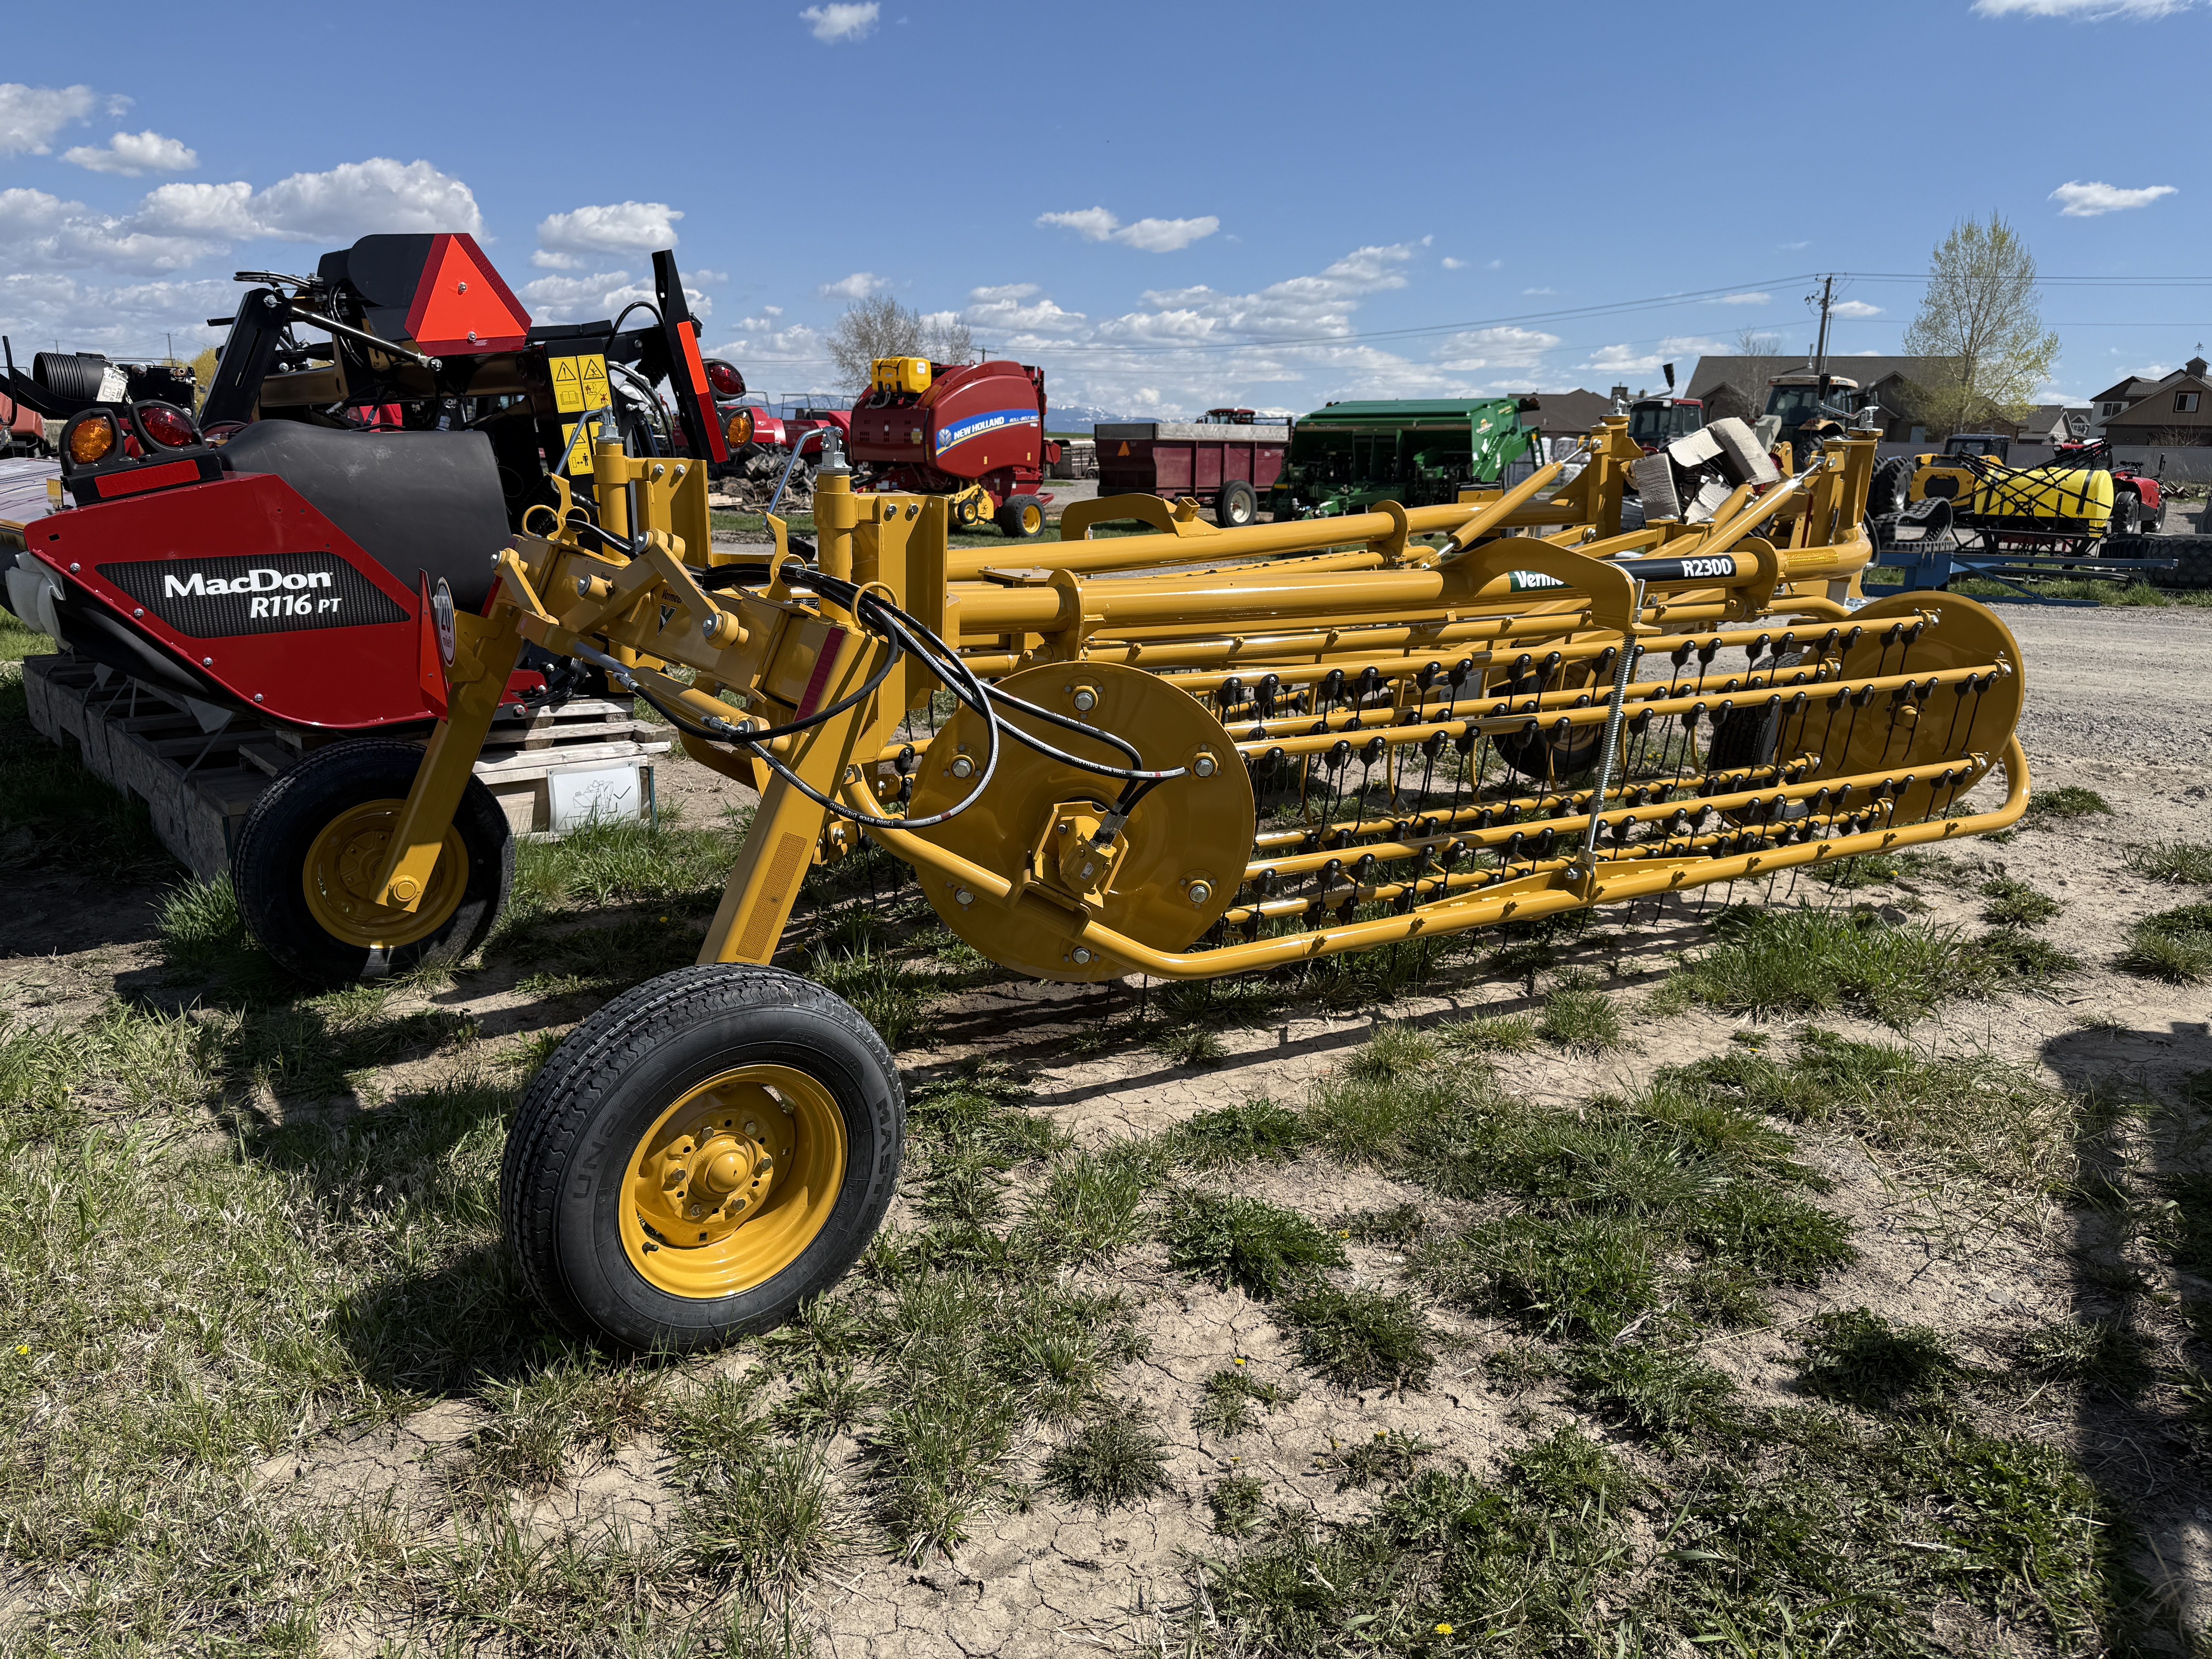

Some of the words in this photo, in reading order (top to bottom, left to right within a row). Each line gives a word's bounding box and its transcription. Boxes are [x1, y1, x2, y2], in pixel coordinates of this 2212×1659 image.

[954, 426, 971, 440] NEW
[972, 416, 1004, 433] HOLLAND
[1681, 559, 1733, 578] R2300
[164, 569, 331, 598] MacDon
[251, 594, 312, 618] R116
[318, 598, 342, 613] PT
[439, 597, 450, 633] 20
[858, 815, 874, 823] RYCO
[833, 1199, 850, 1224] TRAILER
[816, 1224, 836, 1249] SERVICE
[802, 1249, 818, 1265] ONLY
